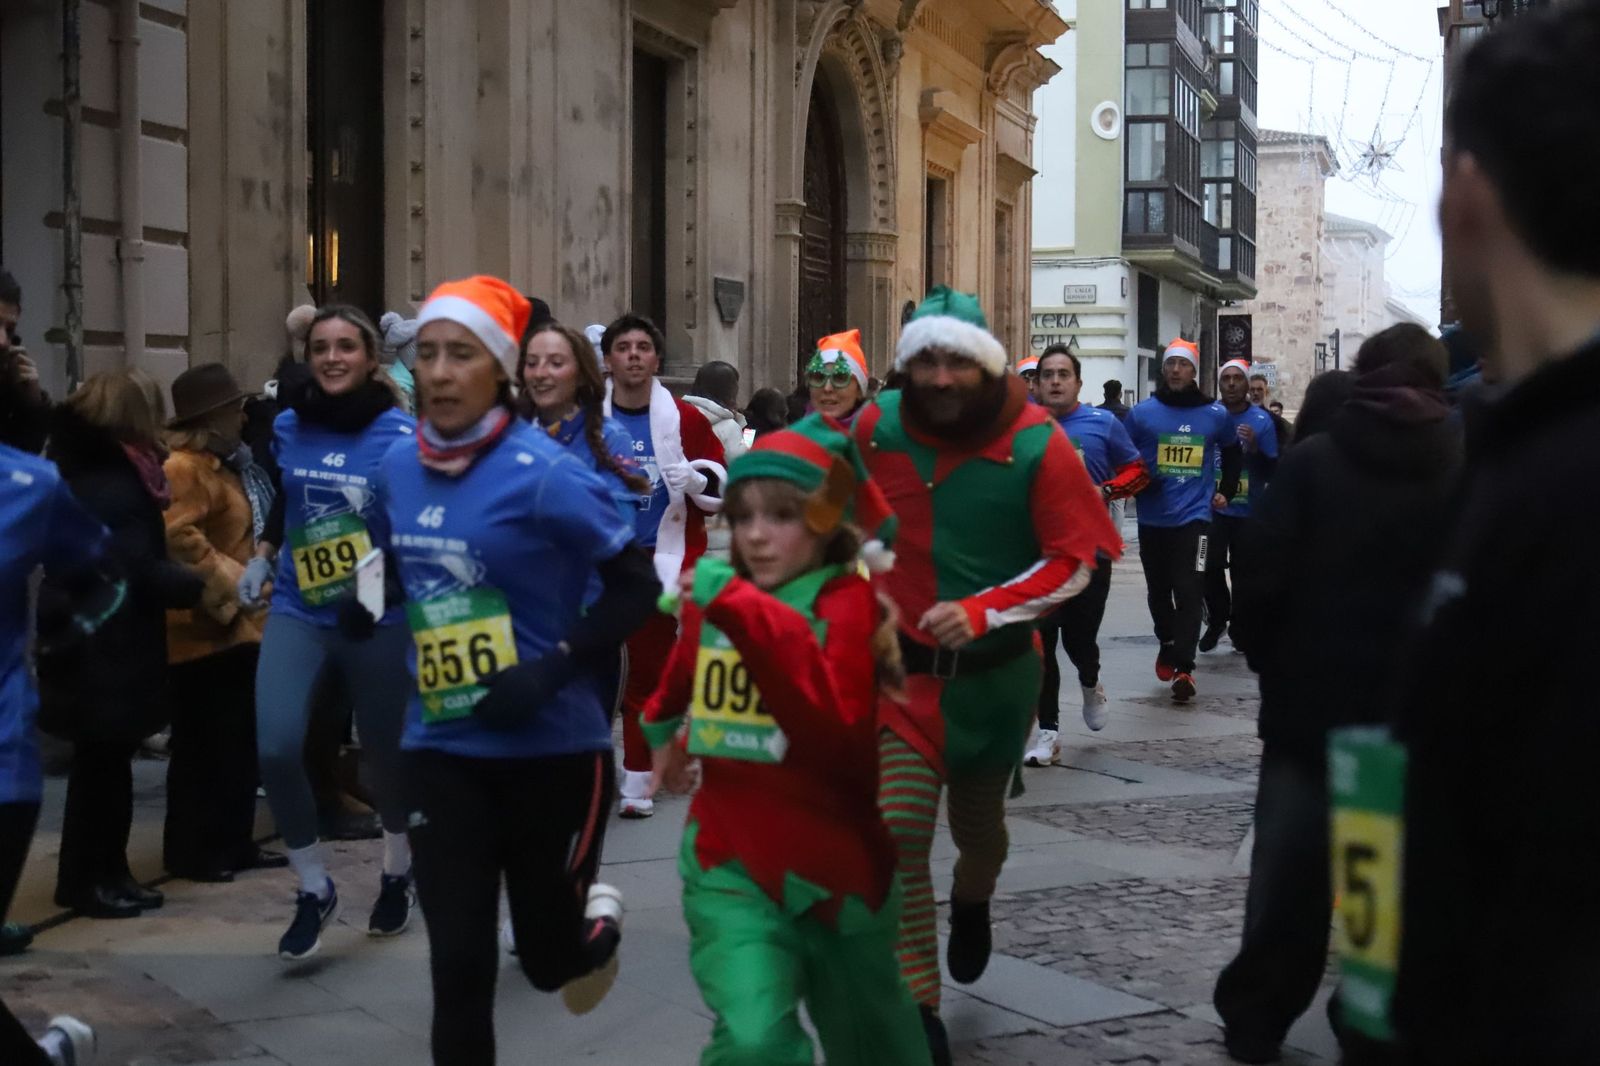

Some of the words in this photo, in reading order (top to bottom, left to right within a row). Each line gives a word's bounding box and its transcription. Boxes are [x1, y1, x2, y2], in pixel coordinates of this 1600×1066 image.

[1178, 424, 1191, 433] 46
[321, 452, 347, 467] 46
[1164, 446, 1194, 463] 1117
[416, 504, 446, 529] 46
[300, 541, 358, 582] 189
[421, 632, 499, 690] 556
[703, 658, 768, 716] 09
